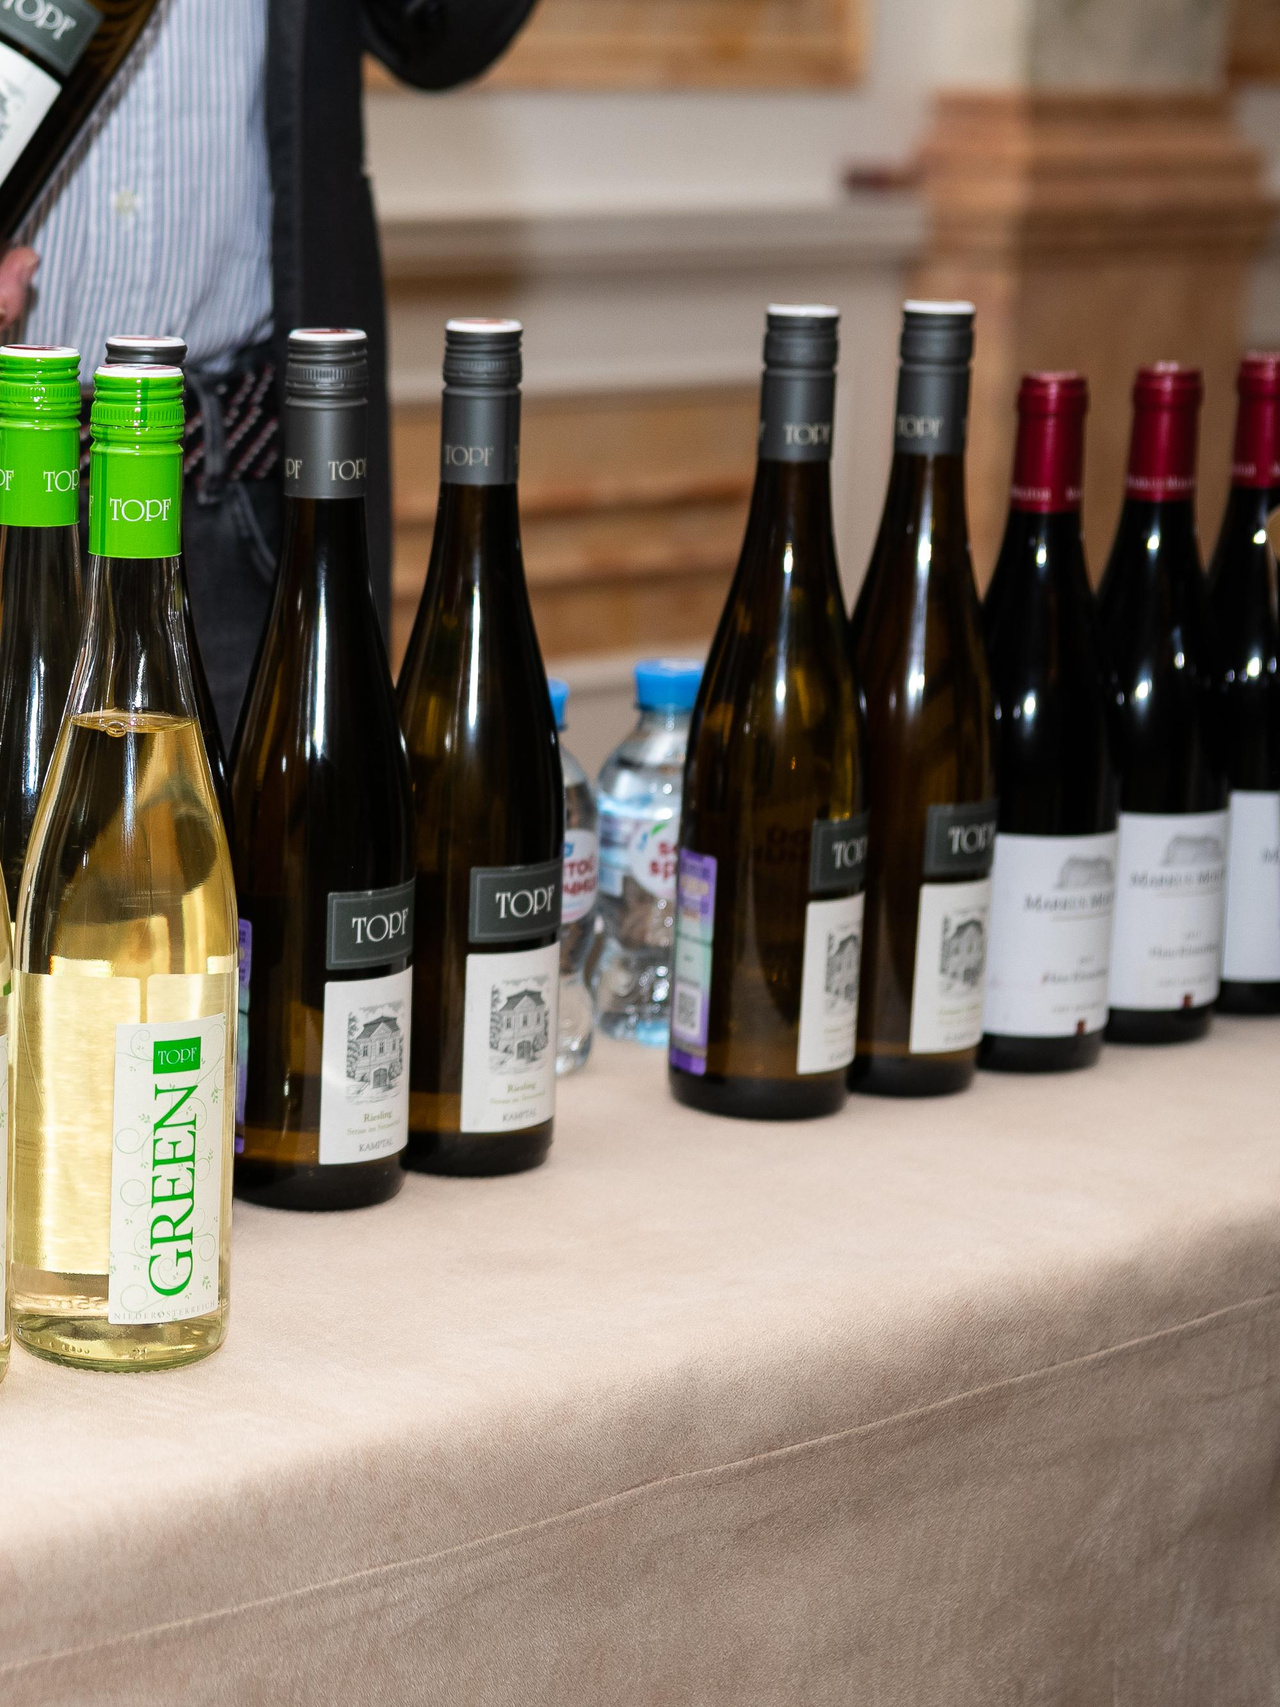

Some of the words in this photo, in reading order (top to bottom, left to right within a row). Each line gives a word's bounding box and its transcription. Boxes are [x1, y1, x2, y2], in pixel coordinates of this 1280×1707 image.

[109, 496, 172, 523] TOPF
[495, 884, 556, 919] TOPF
[351, 908, 410, 944] TOPF
[157, 1046, 198, 1067] TOPF
[363, 1109, 393, 1123] Riesling
[358, 1138, 394, 1152] KAMPTAL
[147, 1083, 199, 1298] GREEN
